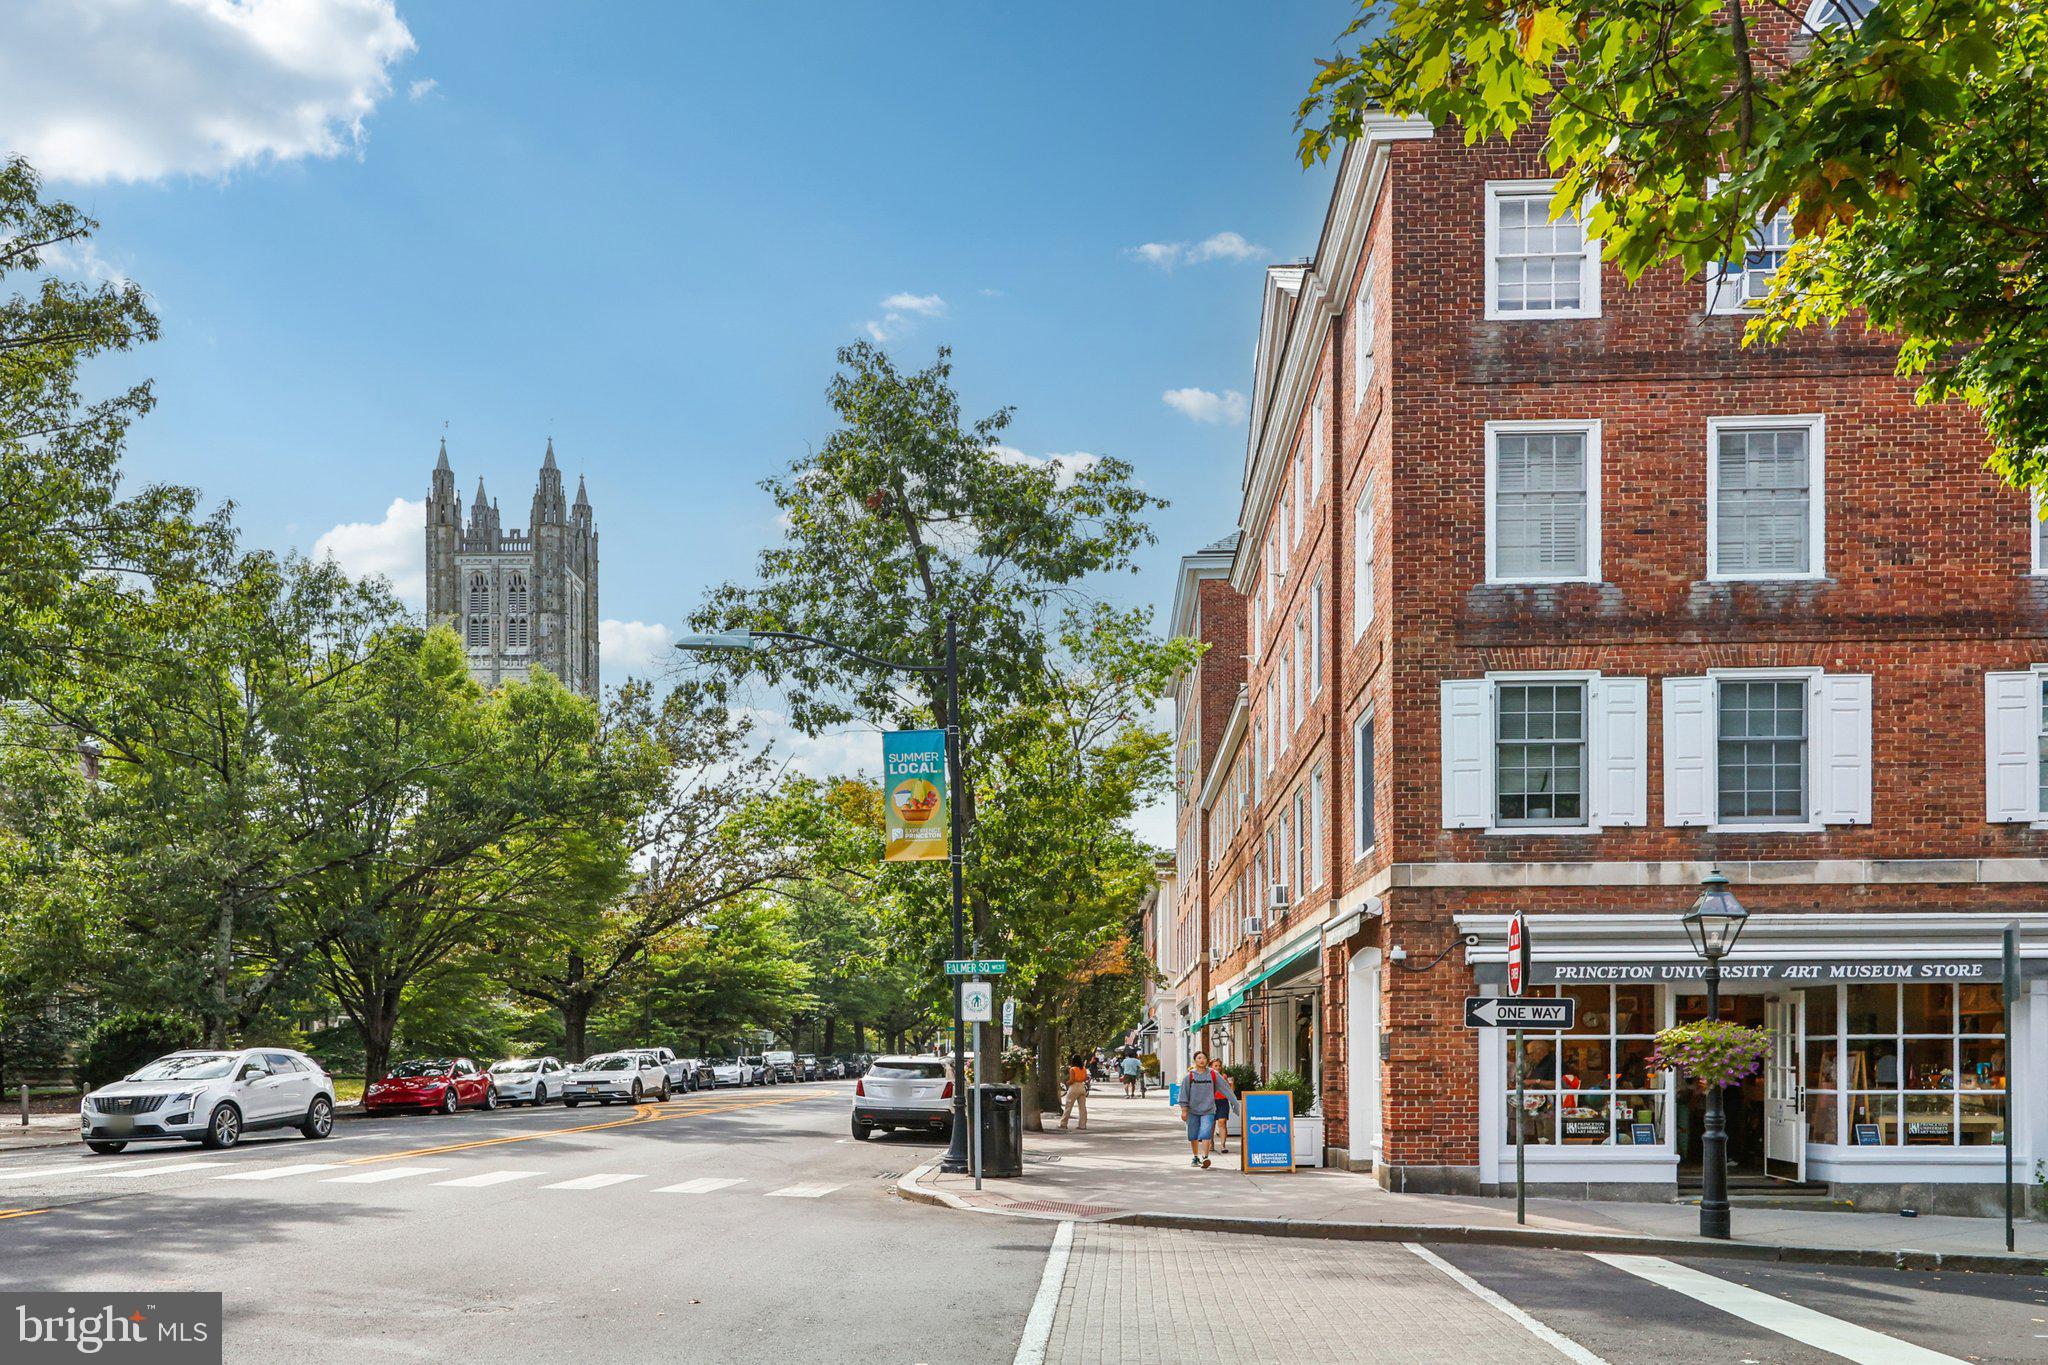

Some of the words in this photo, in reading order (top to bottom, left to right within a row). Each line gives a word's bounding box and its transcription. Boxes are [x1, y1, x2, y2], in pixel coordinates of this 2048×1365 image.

[888, 752, 939, 763] SUMMER
[946, 963, 977, 973] PALMER
[978, 962, 990, 973] SQ
[1554, 966, 1654, 979] PRINCETON
[1661, 965, 1774, 979] UNIVRSITY
[1781, 965, 1822, 978] ART
[1829, 965, 1914, 978] MUSEUM
[1920, 964, 1983, 977] STORE
[1497, 1006, 1526, 1019] ONE
[1531, 1007, 1562, 1019] WAY
[1250, 1124, 1287, 1134] OPEN
